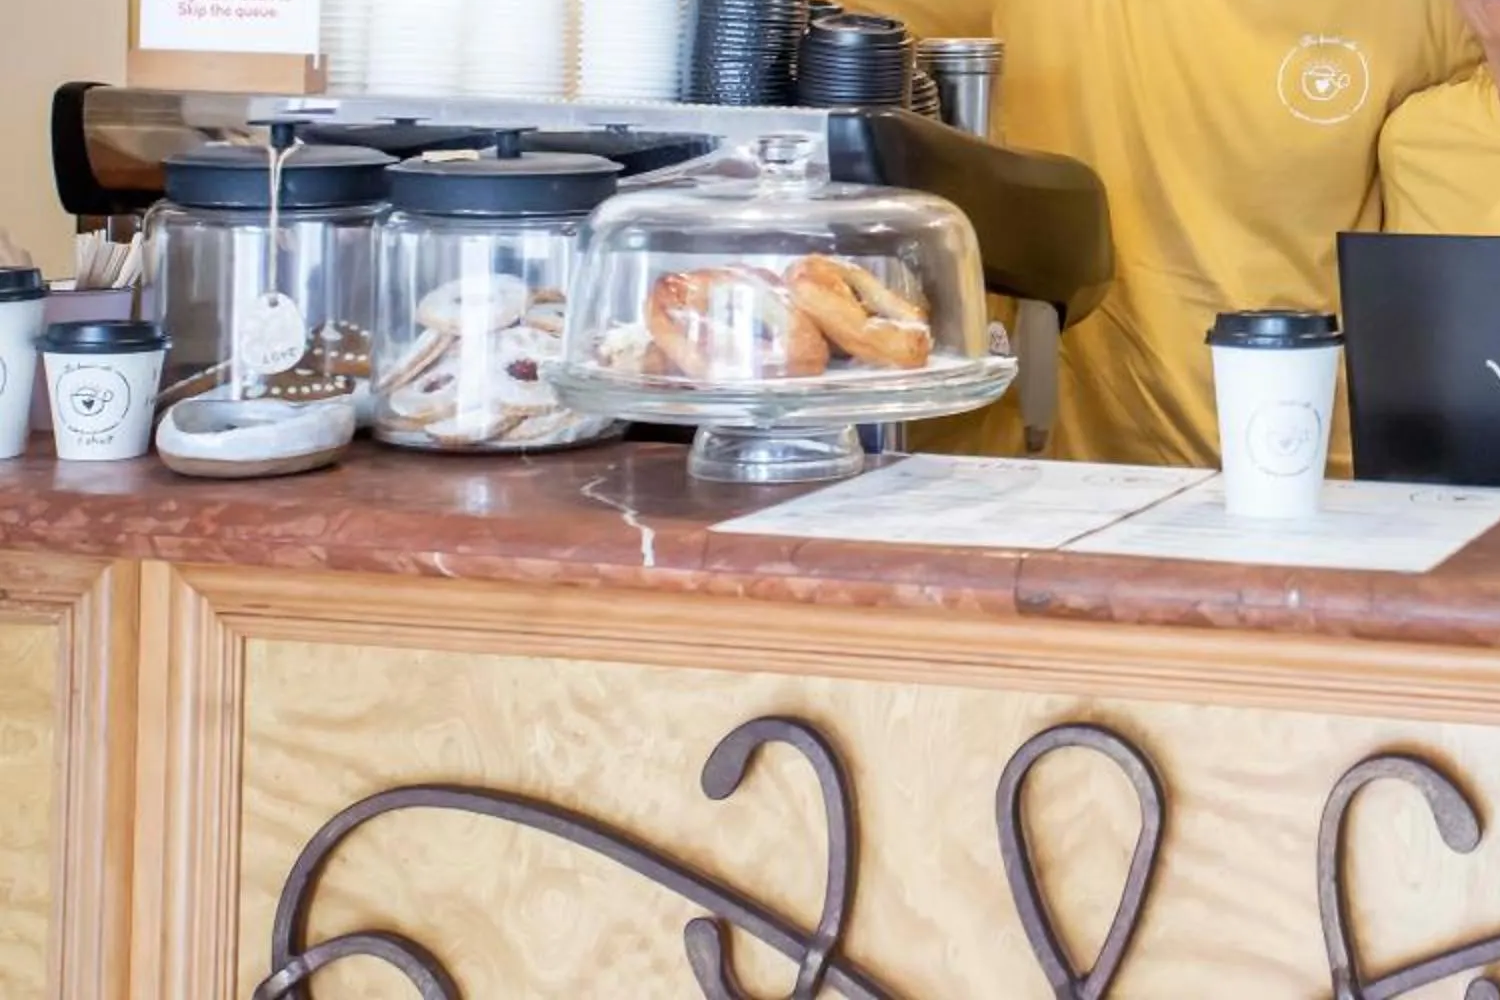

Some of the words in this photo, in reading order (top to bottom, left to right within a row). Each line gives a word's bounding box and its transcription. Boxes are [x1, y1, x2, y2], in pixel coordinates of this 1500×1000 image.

[178, 3, 207, 18] Skip
[210, 4, 233, 17] the
[235, 8, 278, 20] queue
